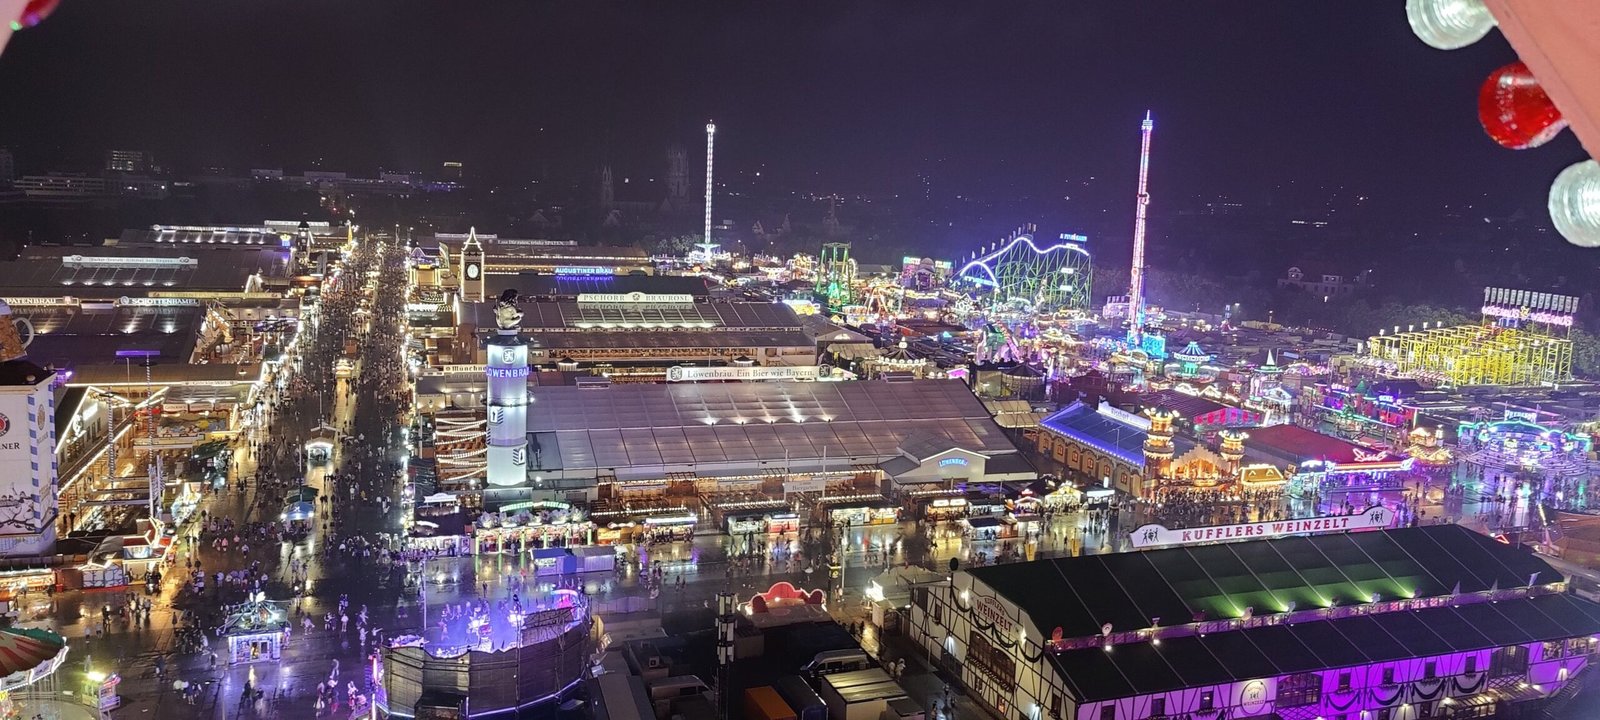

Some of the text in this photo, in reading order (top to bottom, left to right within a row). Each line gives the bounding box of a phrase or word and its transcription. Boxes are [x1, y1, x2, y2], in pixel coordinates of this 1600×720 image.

[687, 369, 734, 378] Löwenbräu.
[737, 369, 750, 377] Ein
[753, 369, 768, 377] Bier
[786, 368, 815, 377] Bayern.
[1182, 518, 1348, 542] KUFFLERS WEINZELT
[976, 600, 1013, 632] WEINZELT
